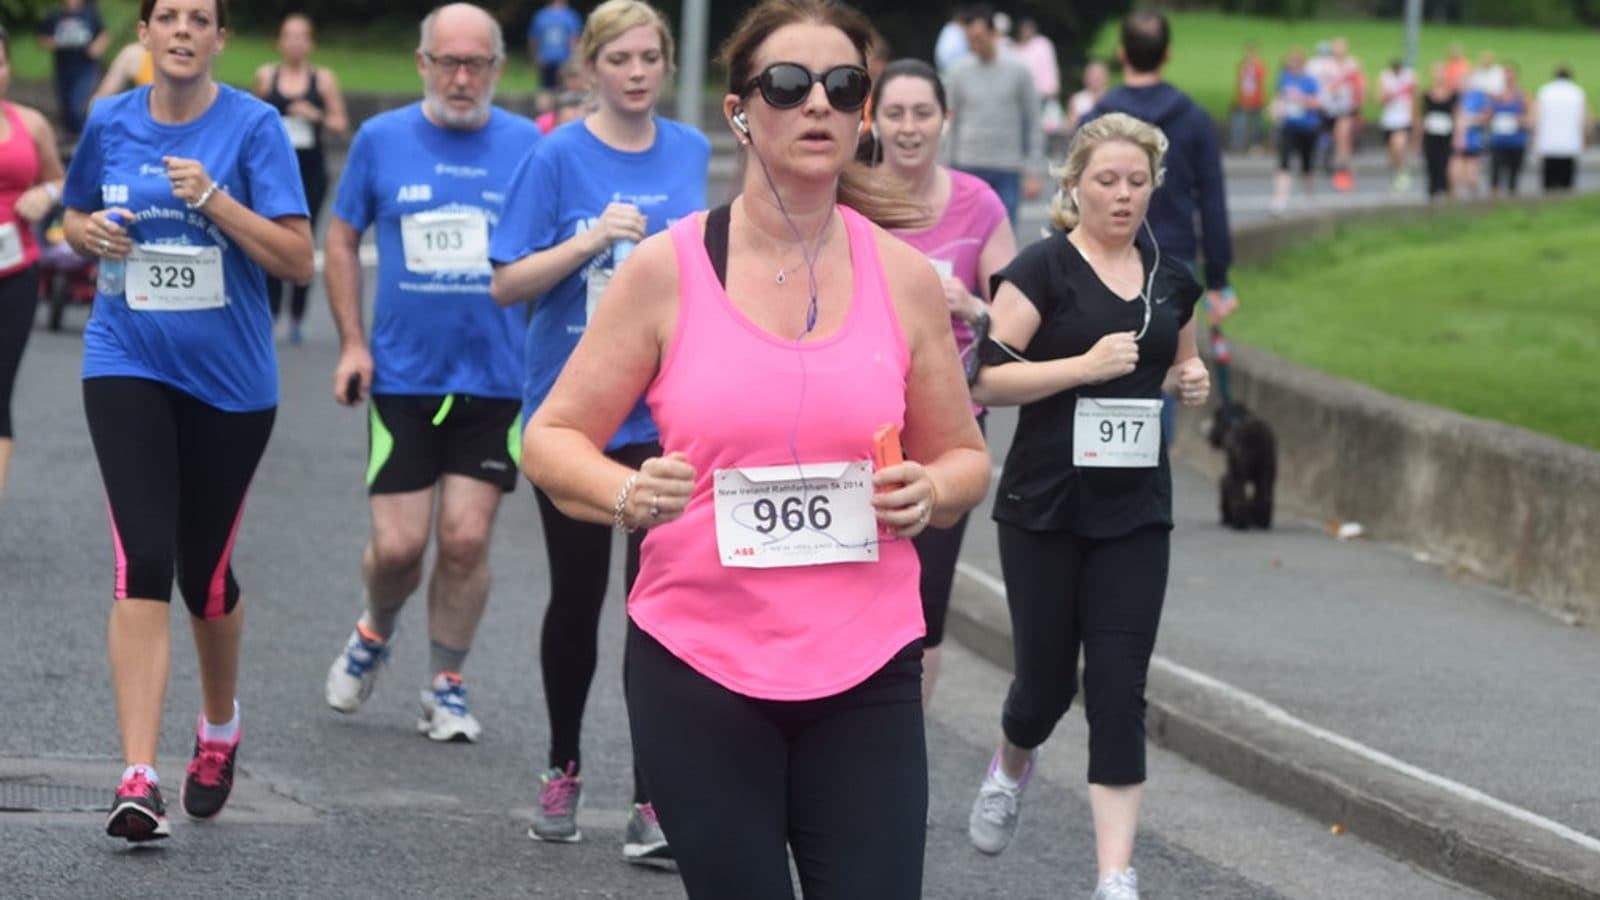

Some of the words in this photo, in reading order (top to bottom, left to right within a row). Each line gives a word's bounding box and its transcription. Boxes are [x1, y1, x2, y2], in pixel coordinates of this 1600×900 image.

[397, 184, 432, 202] ABB
[425, 231, 463, 250] 103
[149, 265, 196, 288] 329
[1100, 419, 1144, 443] 917
[843, 480, 864, 489] 2014
[753, 495, 832, 533] 966
